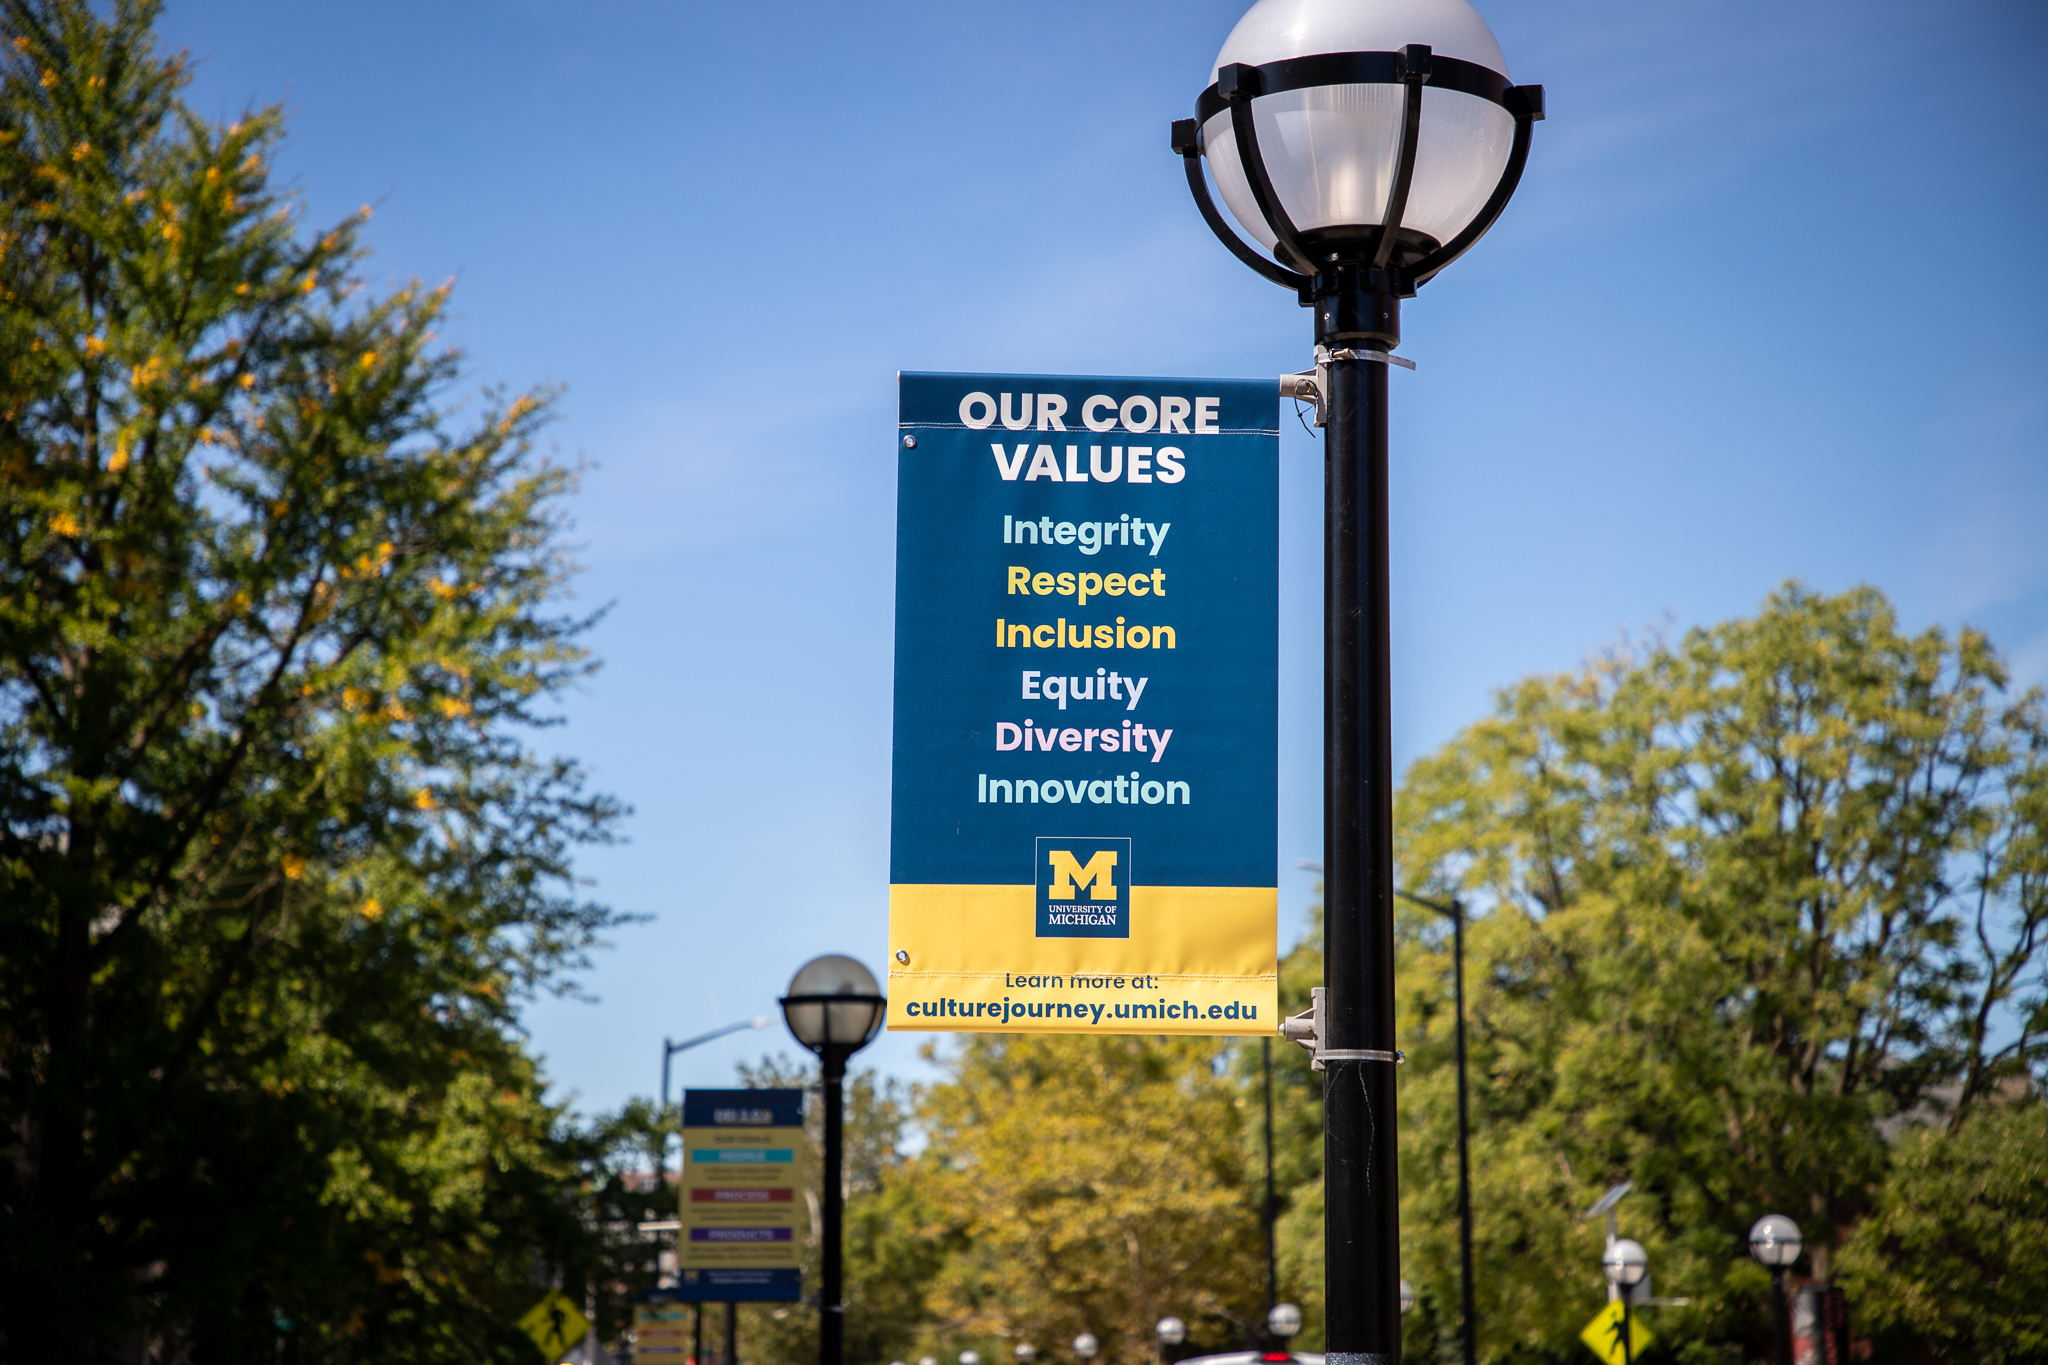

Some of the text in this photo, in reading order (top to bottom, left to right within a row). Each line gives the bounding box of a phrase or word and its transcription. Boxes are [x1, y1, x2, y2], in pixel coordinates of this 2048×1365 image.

[958, 391, 1220, 435] OUR CORE
[990, 443, 1186, 484] VALUES
[1003, 513, 1171, 556] Integrity
[1007, 565, 1166, 606] Respect
[996, 616, 1176, 650] Inclusion
[1021, 667, 1148, 711] Equity
[995, 718, 1173, 763] Diversity
[978, 771, 1191, 805] Innovation
[1048, 850, 1118, 901] M
[1048, 905, 1117, 914] UNIVERSITY OF
[1048, 913, 1117, 926] MICHIGAN
[1005, 972, 1159, 990] Learn more at:
[906, 996, 1257, 1025] culturejourney.umich.edu
